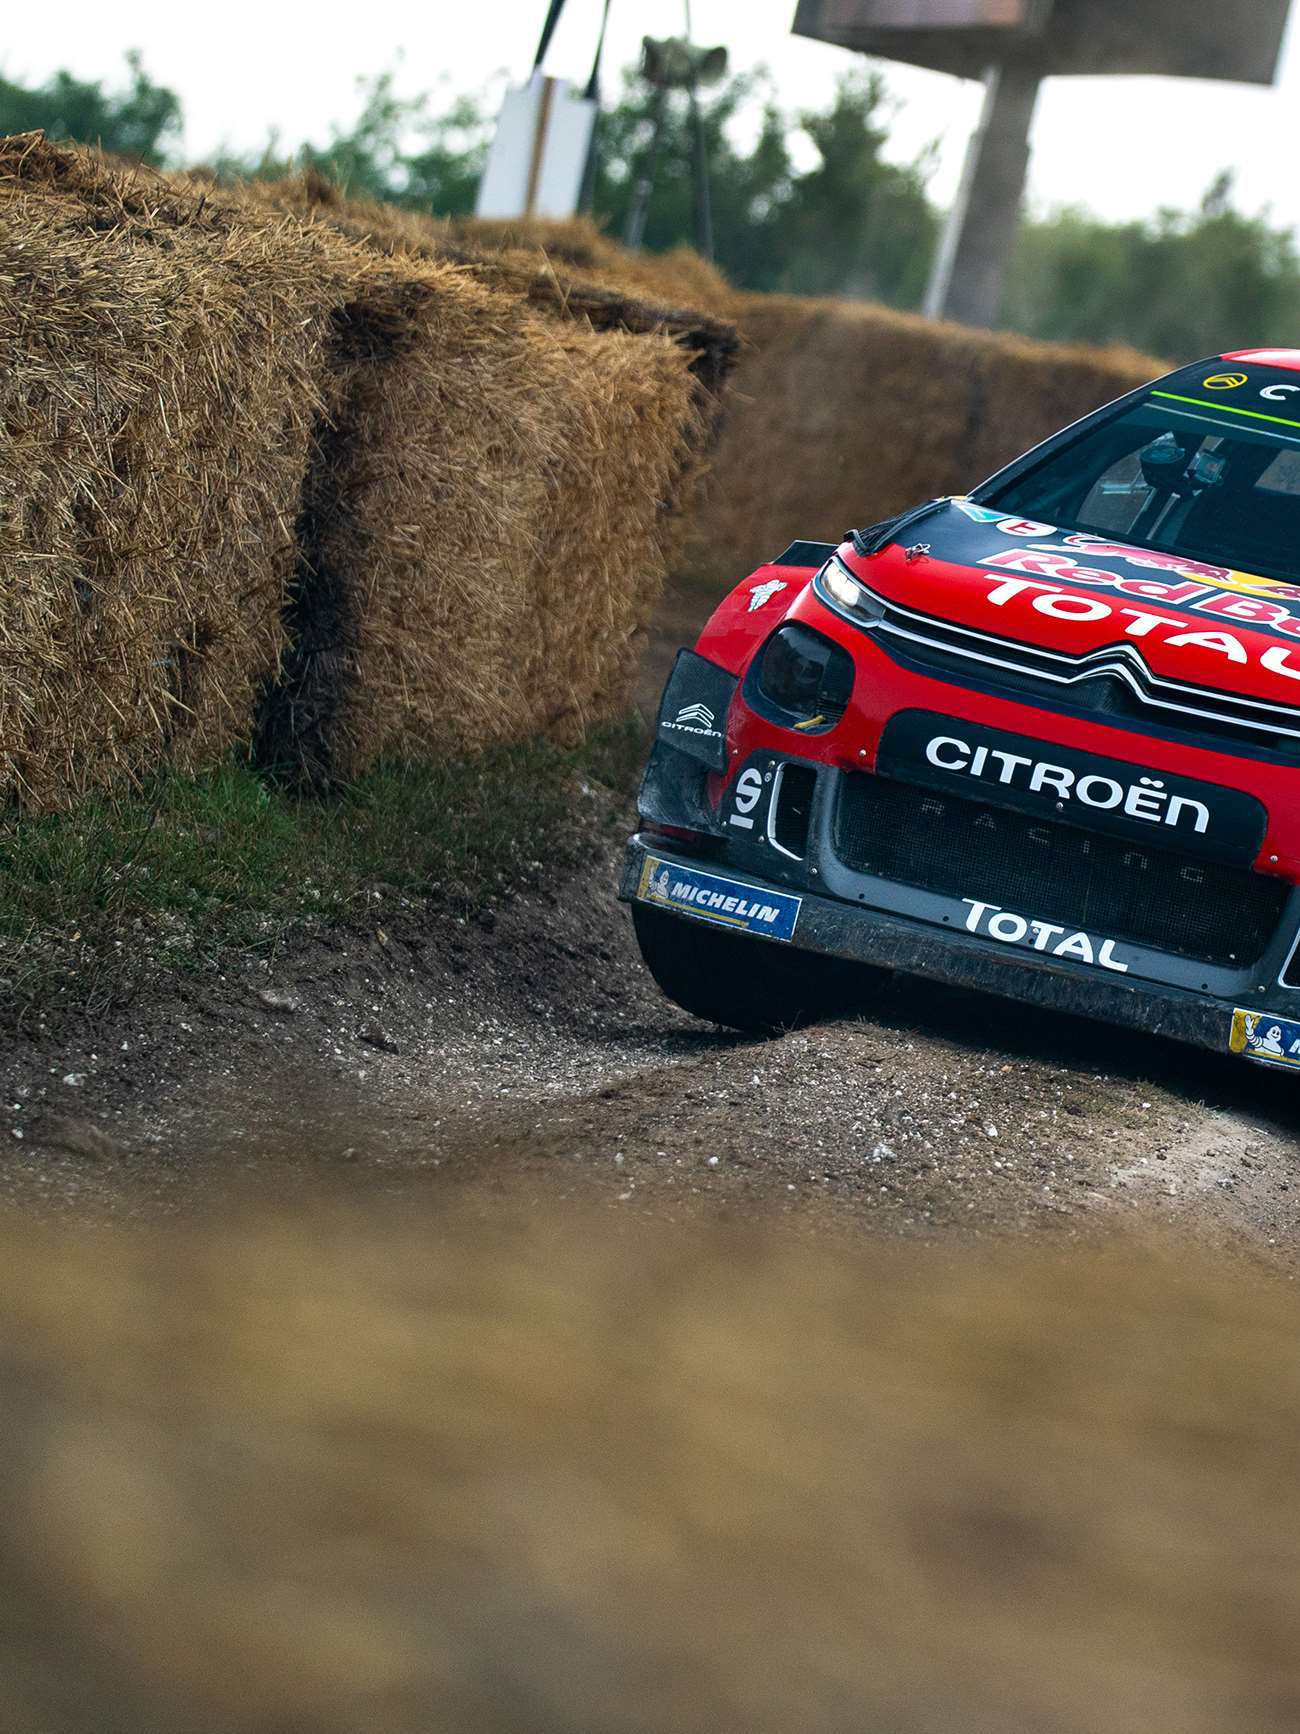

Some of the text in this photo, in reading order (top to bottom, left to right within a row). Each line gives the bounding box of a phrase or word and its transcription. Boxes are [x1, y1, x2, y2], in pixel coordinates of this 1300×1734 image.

[977, 548, 1206, 604] Red
[671, 882, 780, 923] MICHELIN
[962, 898, 1129, 973] TOTAL
